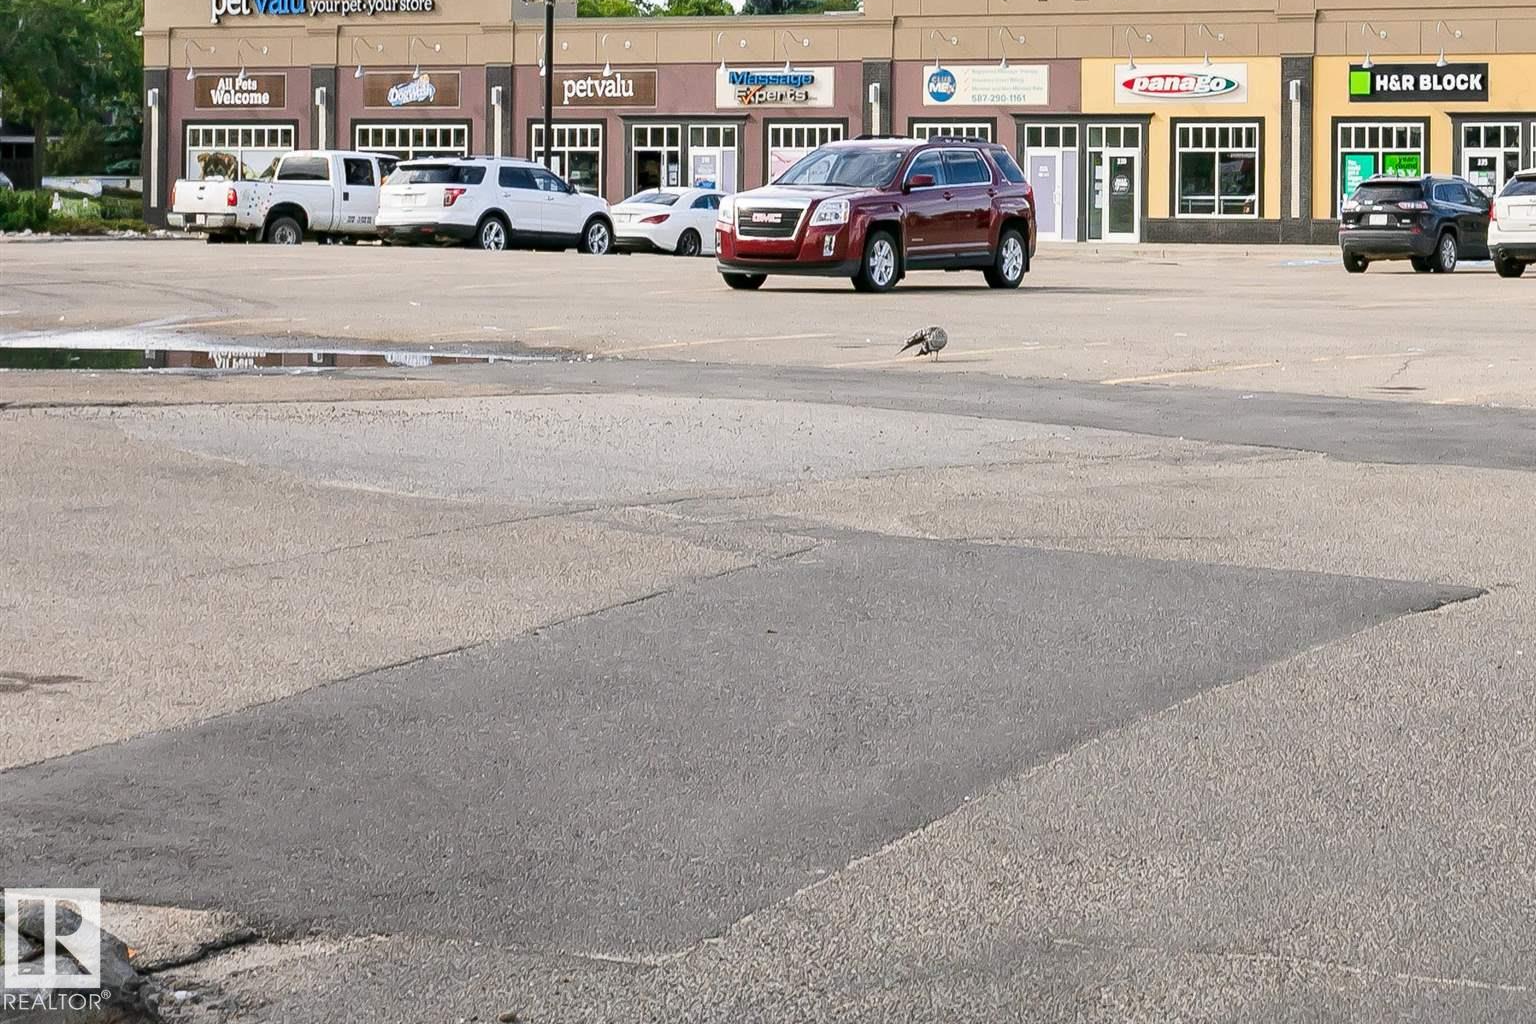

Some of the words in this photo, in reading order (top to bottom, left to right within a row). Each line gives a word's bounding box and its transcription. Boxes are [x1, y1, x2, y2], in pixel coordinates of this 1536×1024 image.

[310, 0, 343, 16] your
[217, 78, 234, 90] All
[236, 78, 257, 91] Pets
[728, 71, 815, 87] Massage
[1131, 75, 1227, 94] panago
[1375, 74, 1415, 91] H&R
[1419, 73, 1482, 91] BLOCK
[210, 89, 270, 105] Welcome
[752, 212, 782, 223] GMC
